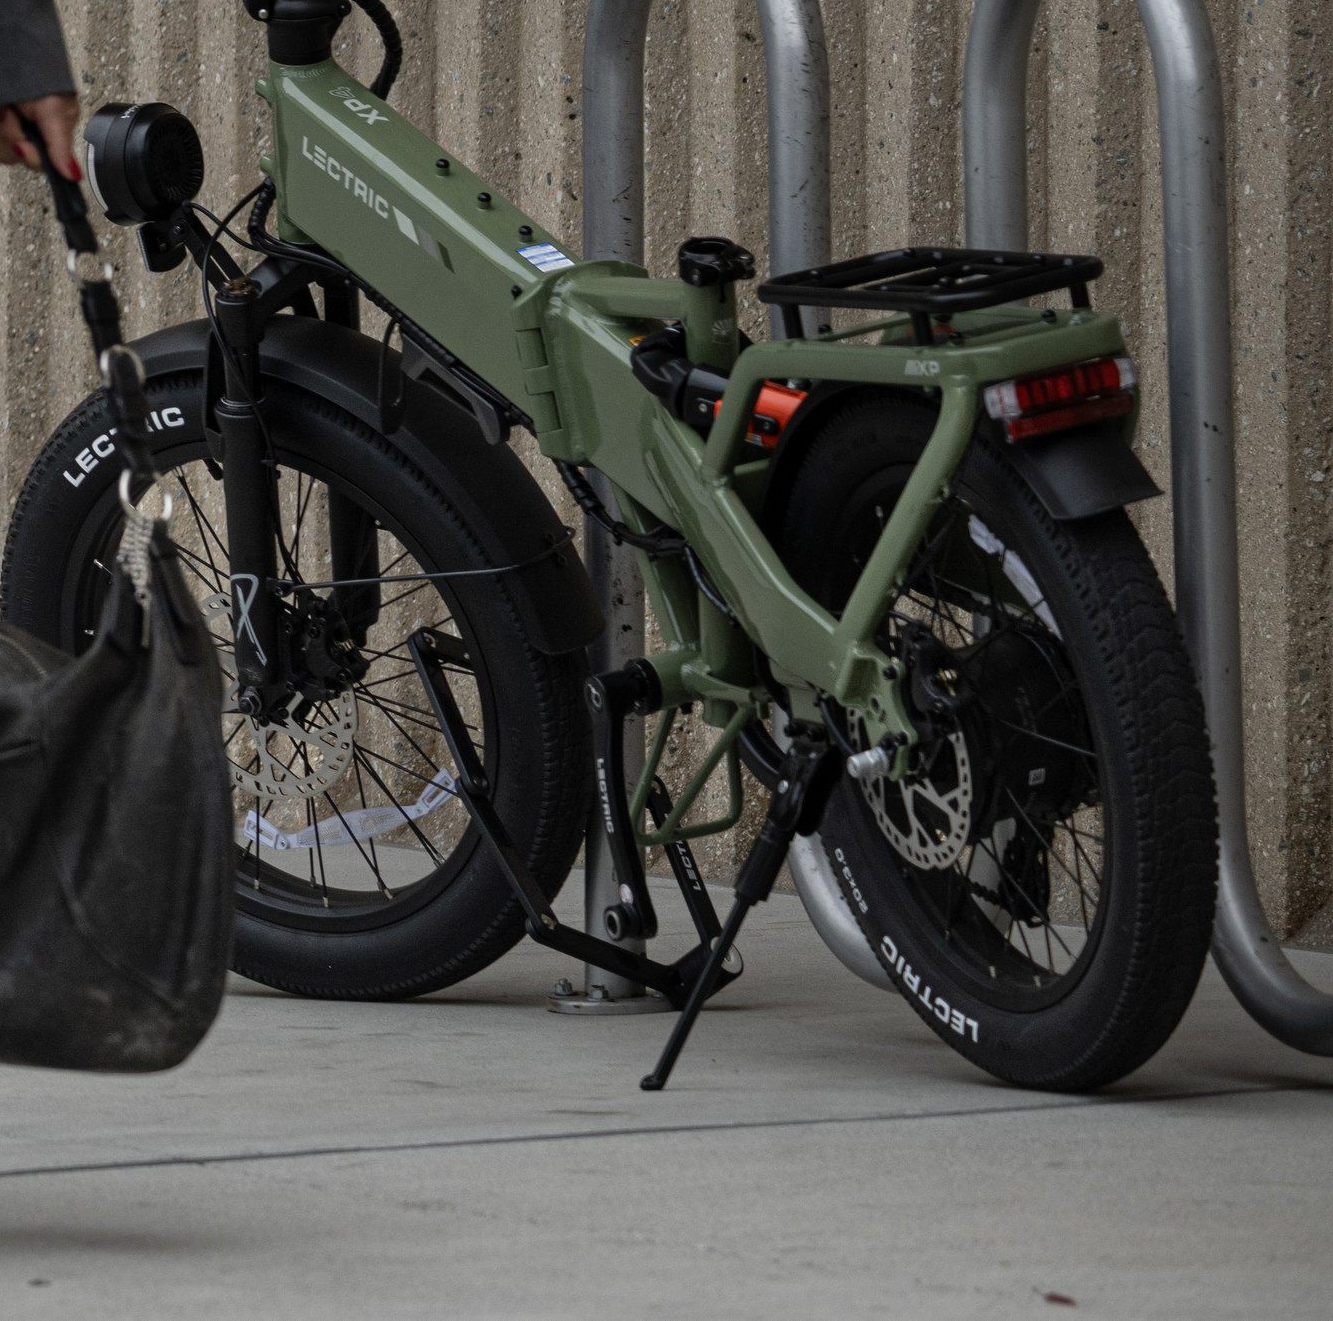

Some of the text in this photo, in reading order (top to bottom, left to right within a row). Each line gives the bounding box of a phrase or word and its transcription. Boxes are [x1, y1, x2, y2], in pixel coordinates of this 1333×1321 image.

[302, 136, 389, 219] LECTRIC
[916, 359, 940, 376] XP
[63, 407, 184, 488] LECIC
[597, 758, 614, 833] LECTRIC
[881, 936, 979, 1043] LECTRIC
